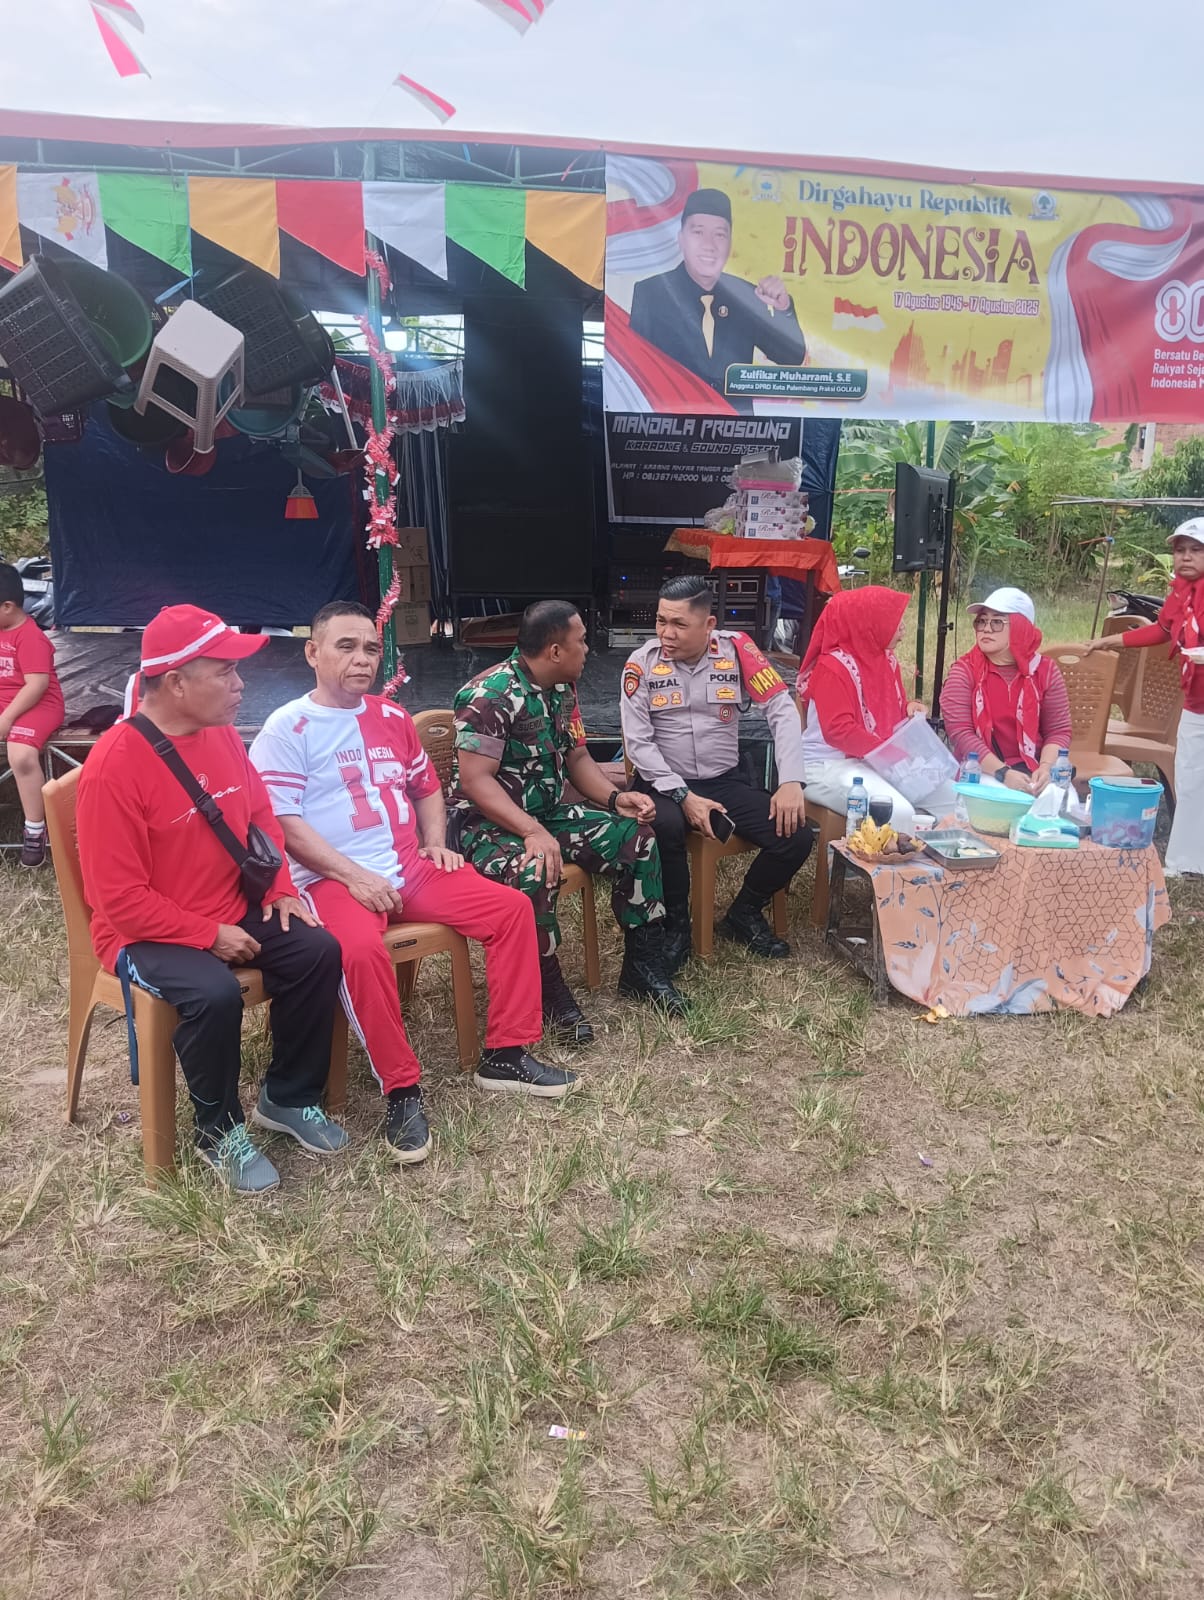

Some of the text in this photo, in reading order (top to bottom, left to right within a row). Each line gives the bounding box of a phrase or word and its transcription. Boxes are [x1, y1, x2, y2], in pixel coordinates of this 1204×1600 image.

[799, 180, 1012, 216] Dirgahayu Republik
[782, 216, 1041, 285] INDONESIA
[894, 292, 904, 308] 17
[904, 292, 940, 311] Agustus
[941, 295, 963, 311] 1945
[969, 296, 979, 312] 17
[979, 296, 1016, 315] Agustus
[1015, 299, 1040, 316] 2025
[1154, 348, 1191, 360] Bersatu
[740, 370, 777, 380] Zulfikar
[1152, 363, 1185, 377] Rakyat
[729, 382, 754, 391] Anggota
[786, 384, 818, 393] Palembang
[1151, 377, 1197, 388] Indonesia
[612, 415, 791, 442] MANDALA PROSOUND
[625, 439, 681, 452] KARAOKE
[690, 442, 731, 454] SOUND
[648, 677, 680, 690] RIZAL
[709, 673, 739, 683] POLRI
[335, 747, 395, 764] INDO NESIA
